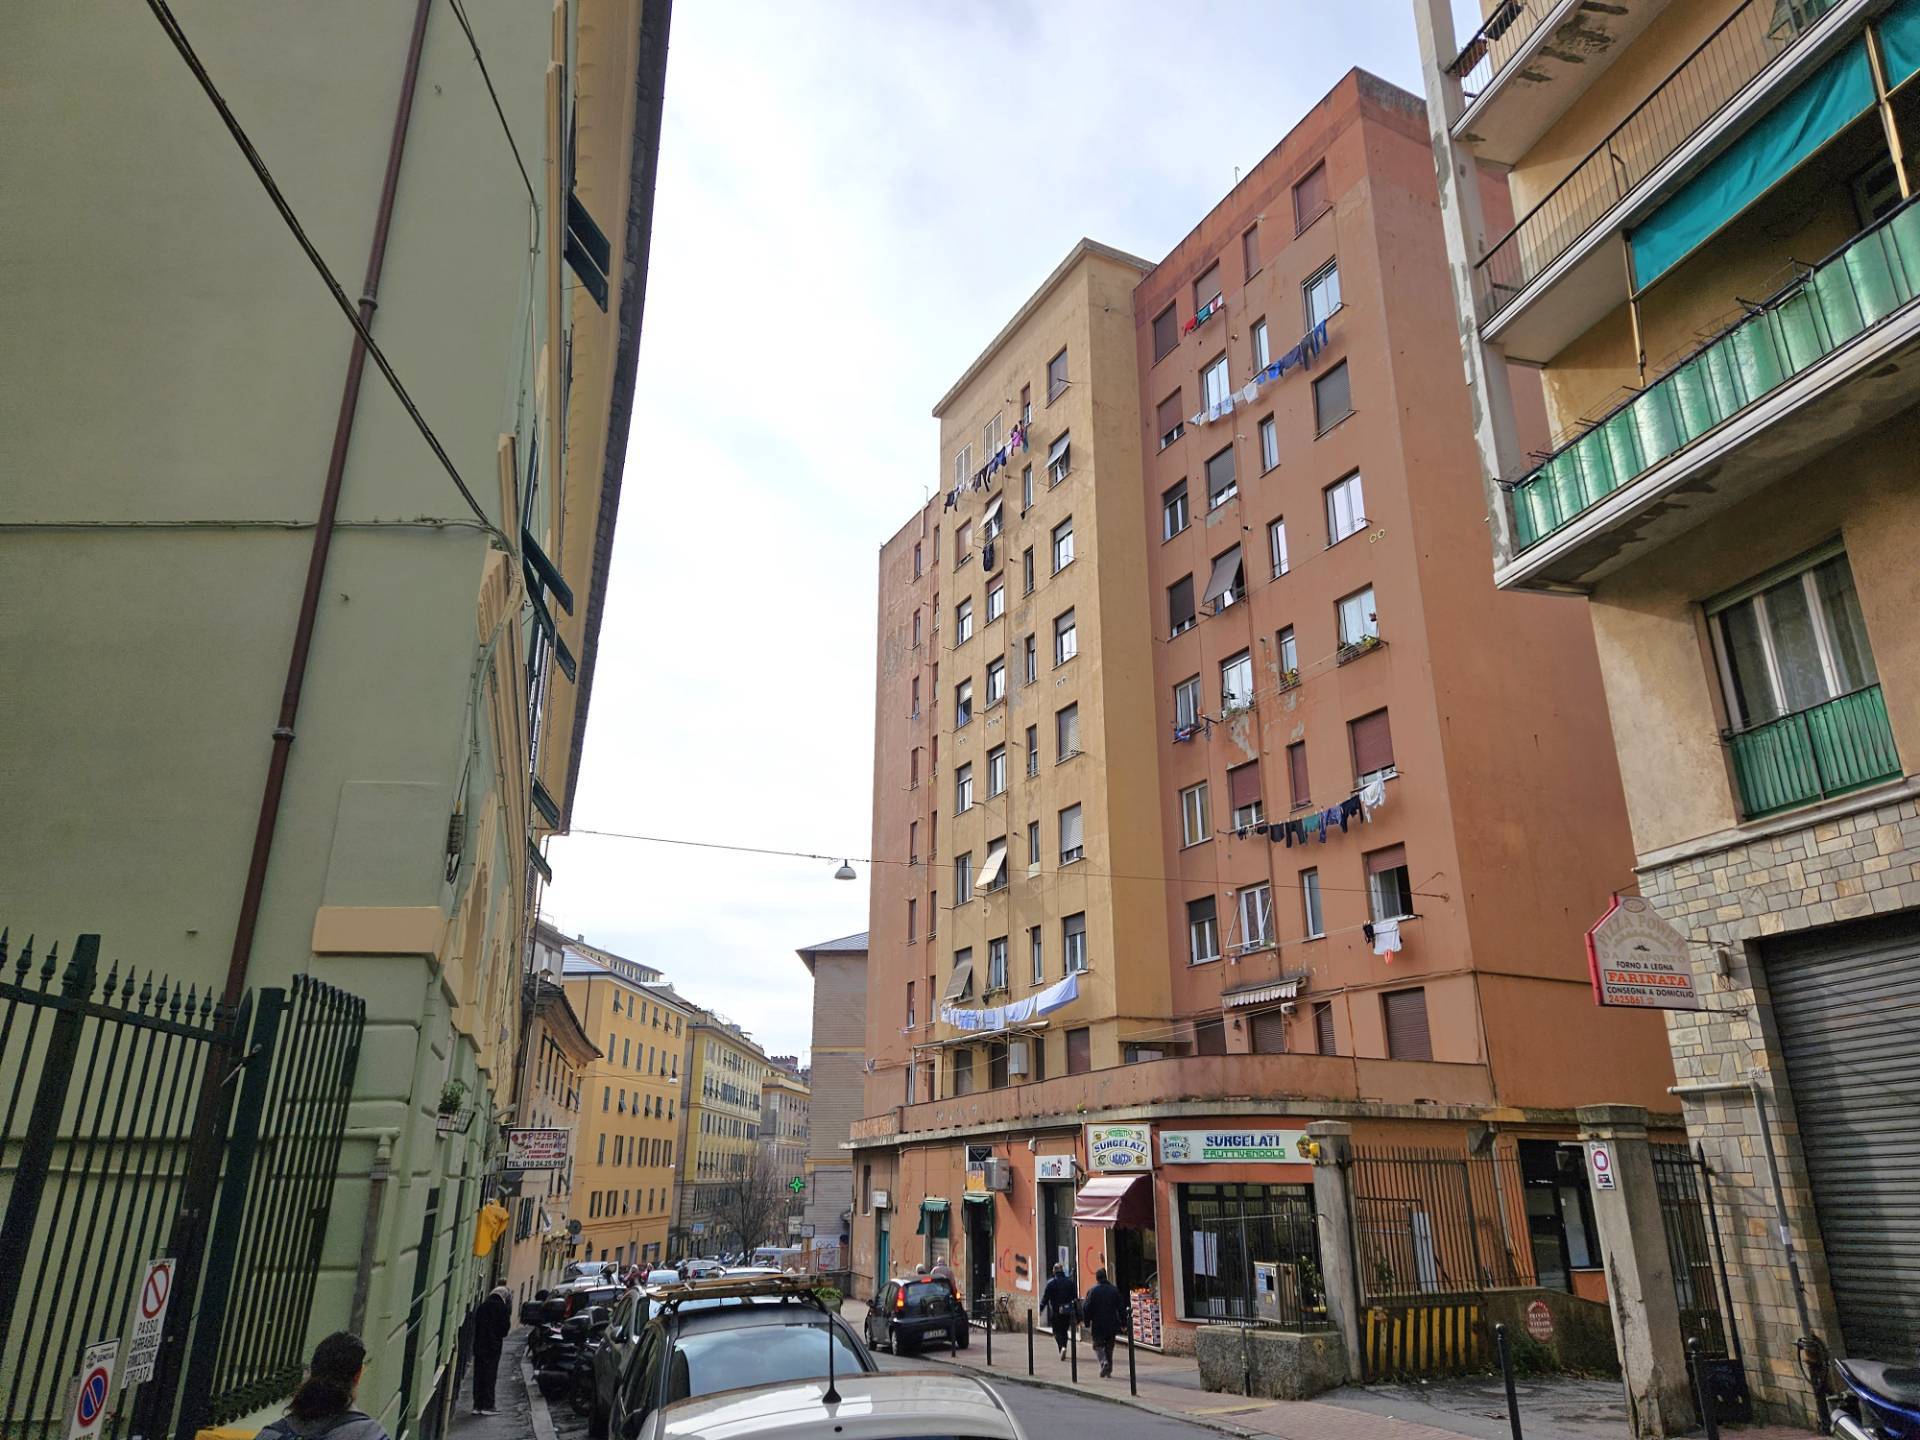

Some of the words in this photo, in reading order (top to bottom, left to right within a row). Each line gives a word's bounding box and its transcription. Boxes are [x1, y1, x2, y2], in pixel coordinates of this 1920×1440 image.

[1598, 914, 1633, 947] PIZZA
[1602, 950, 1620, 960] DA
[1616, 961, 1641, 969] FORNO
[1607, 971, 1688, 986] FARINATA
[1607, 986, 1646, 995] CONSEGNA
[1656, 989, 1694, 998] DOMICILIO
[528, 1132, 567, 1140] PIZZERIA
[1206, 1134, 1280, 1147] SURGELATI
[1094, 1139, 1145, 1152] SURGELATI
[1203, 1149, 1286, 1158] FRUTTIVENDOLO
[137, 1319, 160, 1334] PASSO
[131, 1332, 161, 1353] CARRABILE
[127, 1349, 157, 1368] RIMOZIONE
[124, 1366, 152, 1387] FORZATA
